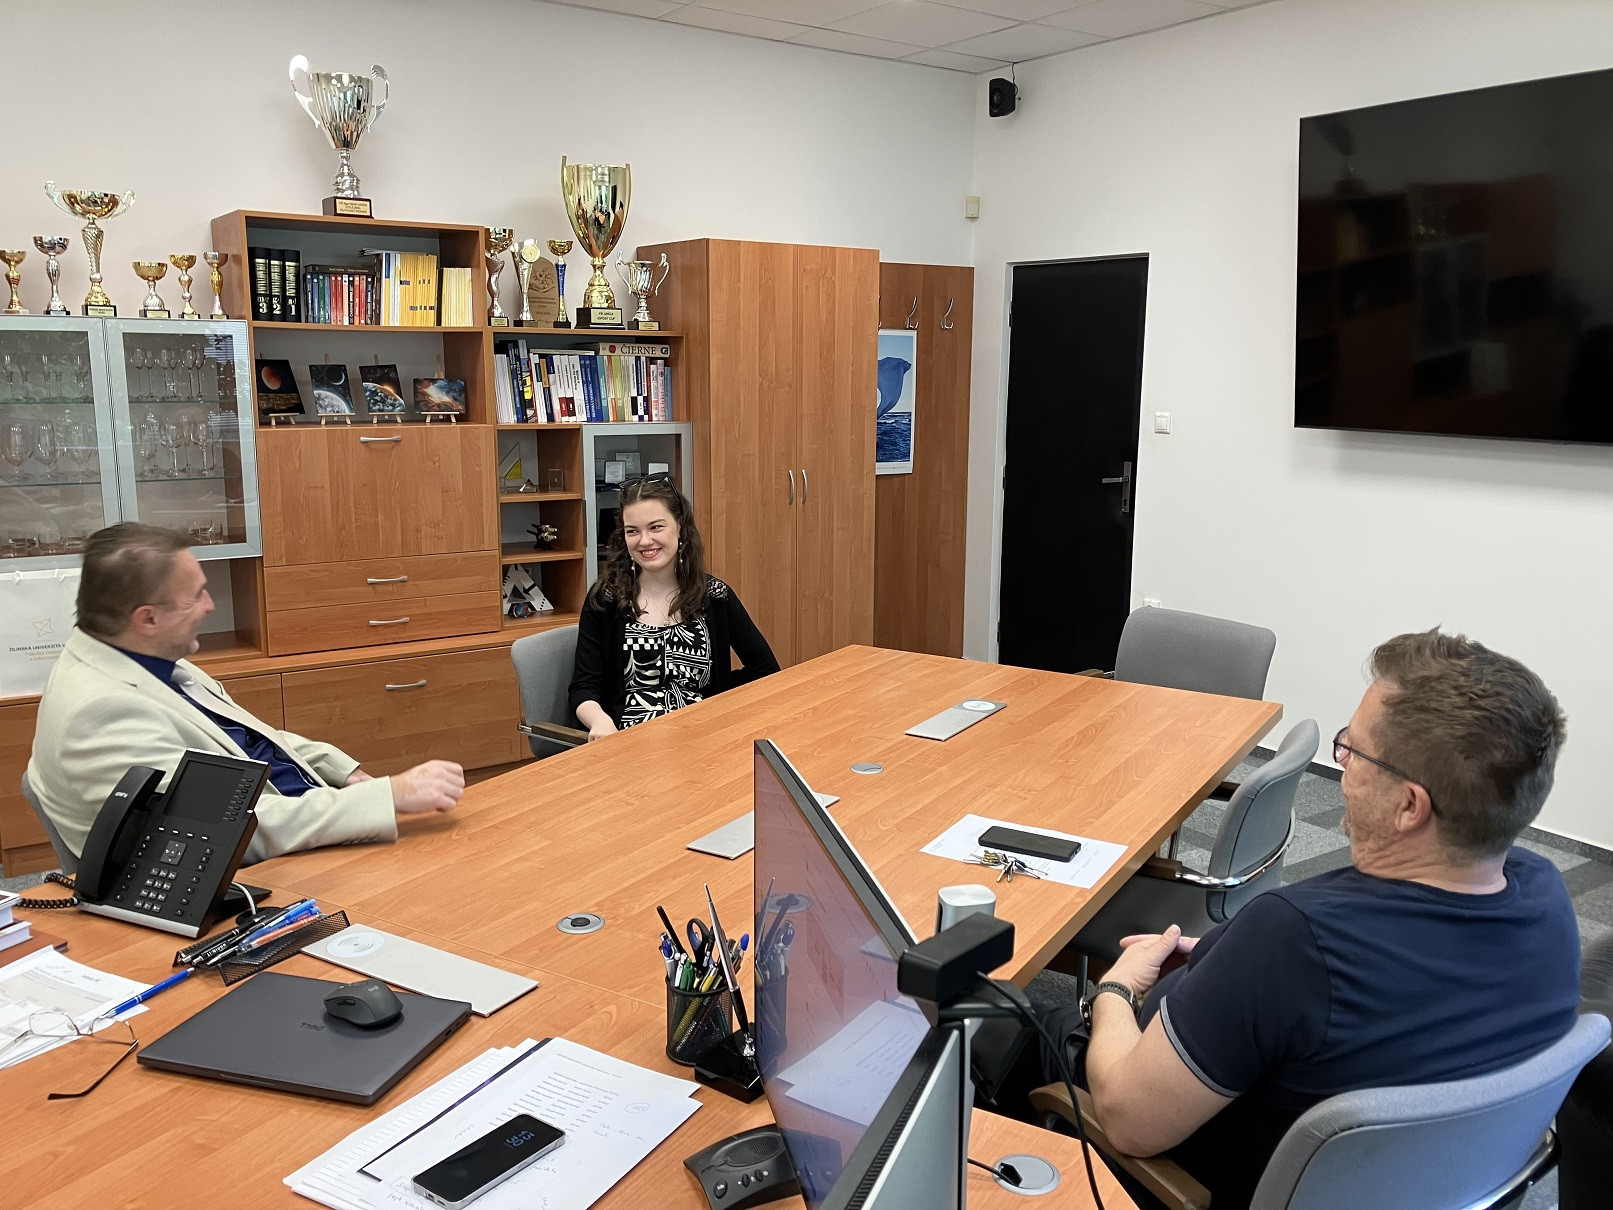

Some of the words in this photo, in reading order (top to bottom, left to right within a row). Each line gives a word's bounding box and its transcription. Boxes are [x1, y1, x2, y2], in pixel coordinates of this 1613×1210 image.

[259, 303, 268, 314] 3
[272, 304, 282, 315] 2
[291, 305, 296, 316] 1
[621, 344, 656, 355] ČIERNE
